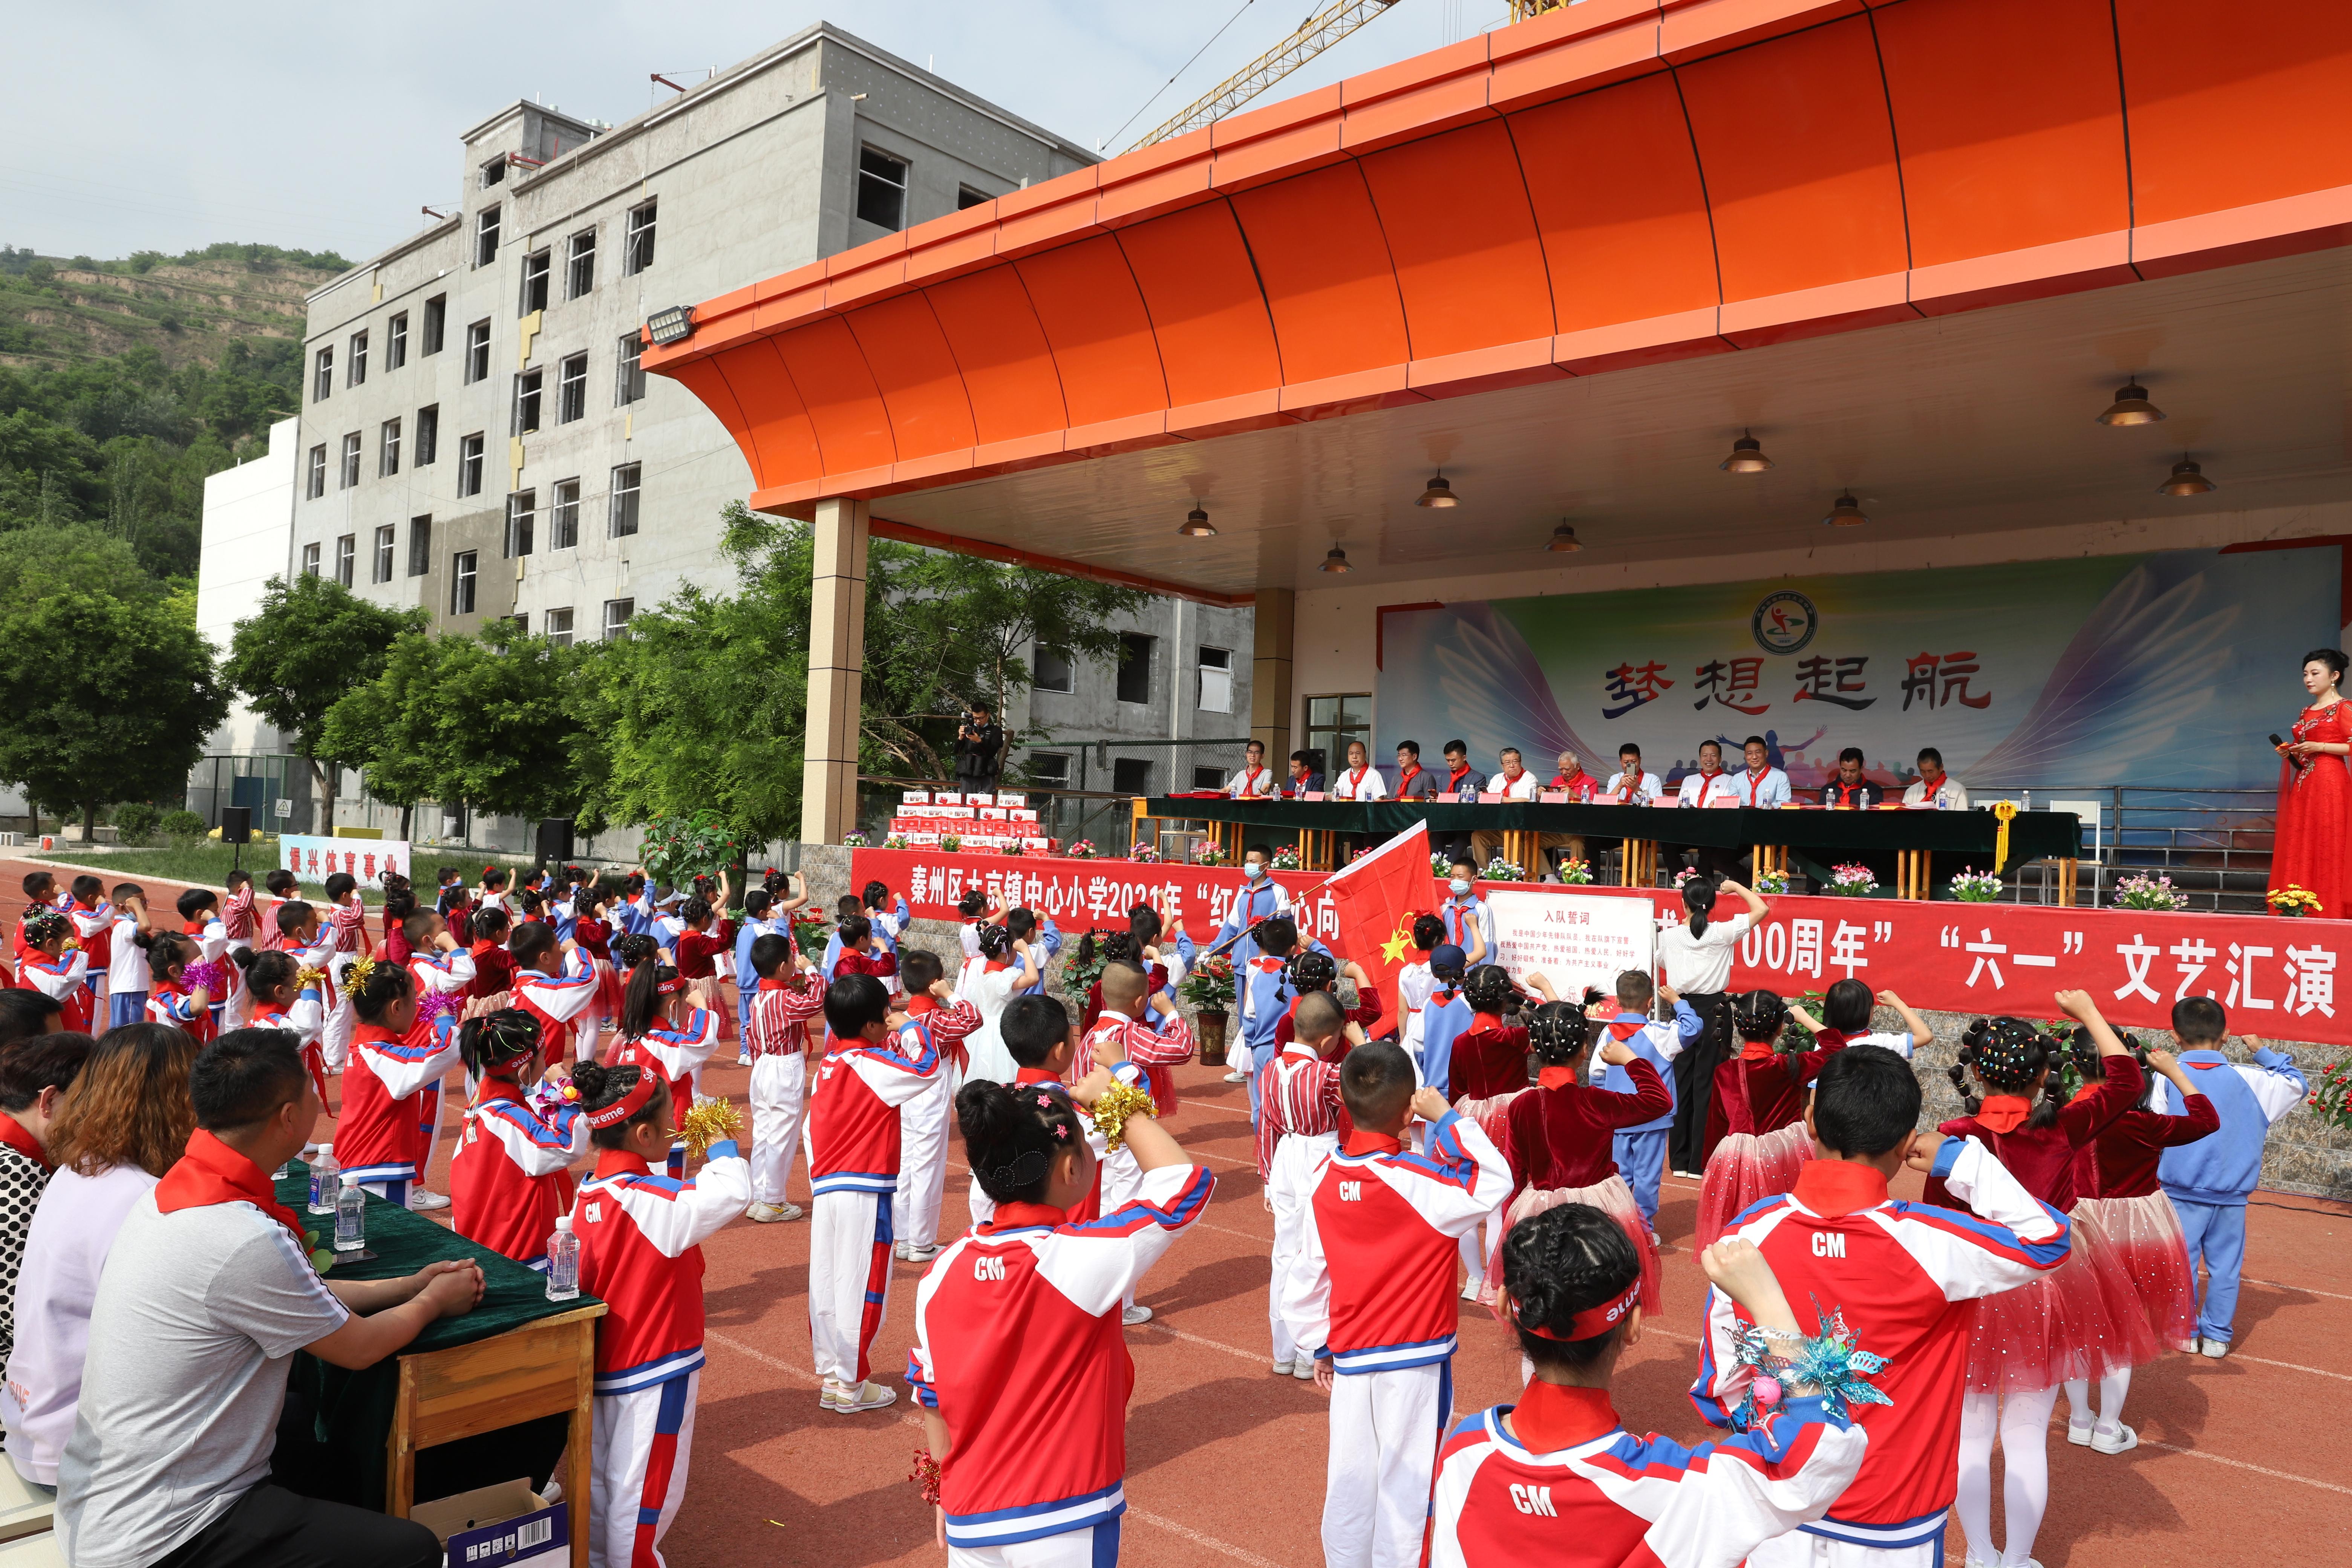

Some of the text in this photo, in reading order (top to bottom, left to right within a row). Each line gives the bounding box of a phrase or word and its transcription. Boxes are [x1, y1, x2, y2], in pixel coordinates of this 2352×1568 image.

[1602, 652, 1991, 719] 梦想起航
[289, 847, 397, 881] 振兴体育事业
[1544, 910, 1590, 925] 入队誓词
[1500, 965, 1525, 974] 献力量！
[1940, 925, 2084, 990] “六一”
[2113, 933, 2337, 1019] 文艺汇演
[1339, 1181, 1361, 1201] CM
[585, 1201, 602, 1223] CM
[1812, 1232, 1846, 1258] CM
[974, 1256, 1006, 1281] CM
[1509, 1483, 1558, 1517] CM
